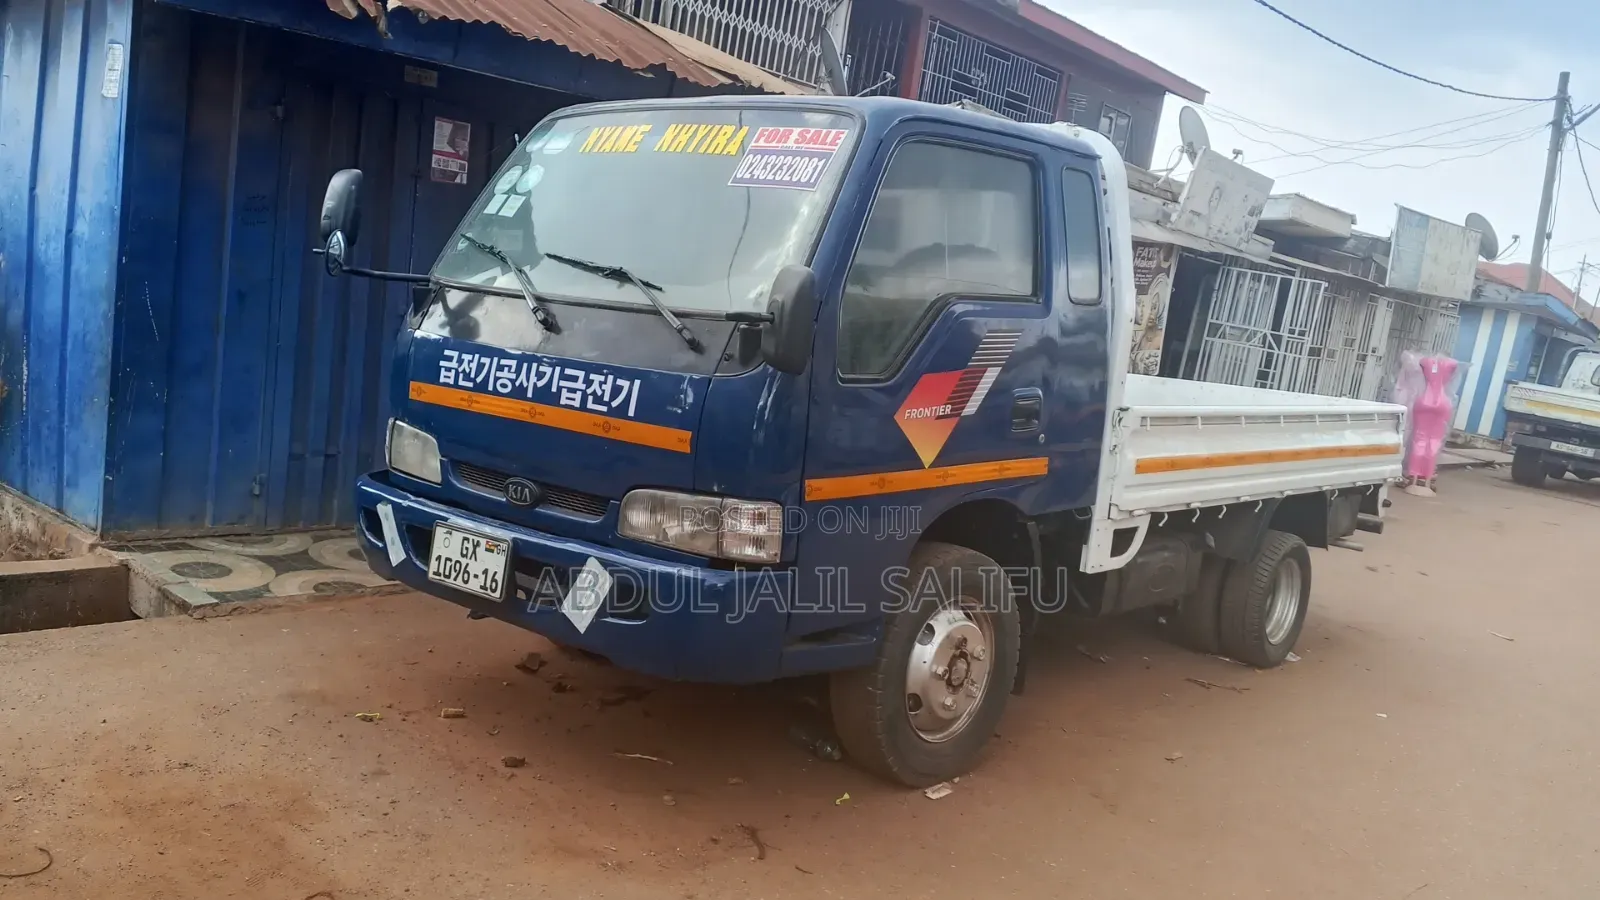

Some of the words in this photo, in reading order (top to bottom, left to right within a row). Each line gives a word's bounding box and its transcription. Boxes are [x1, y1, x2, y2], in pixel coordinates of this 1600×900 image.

[579, 124, 653, 153] NYAME
[653, 123, 750, 156] NHYIRA
[753, 127, 794, 144] FOR
[793, 128, 845, 147] SALE
[736, 153, 827, 183] 0243232081
[439, 349, 642, 418] 급전기공사기급전기
[904, 404, 952, 420] FRONTIER
[508, 484, 531, 502] KIA
[460, 536, 481, 562] GX
[496, 544, 507, 557] GH
[432, 554, 499, 594] 1096-16
